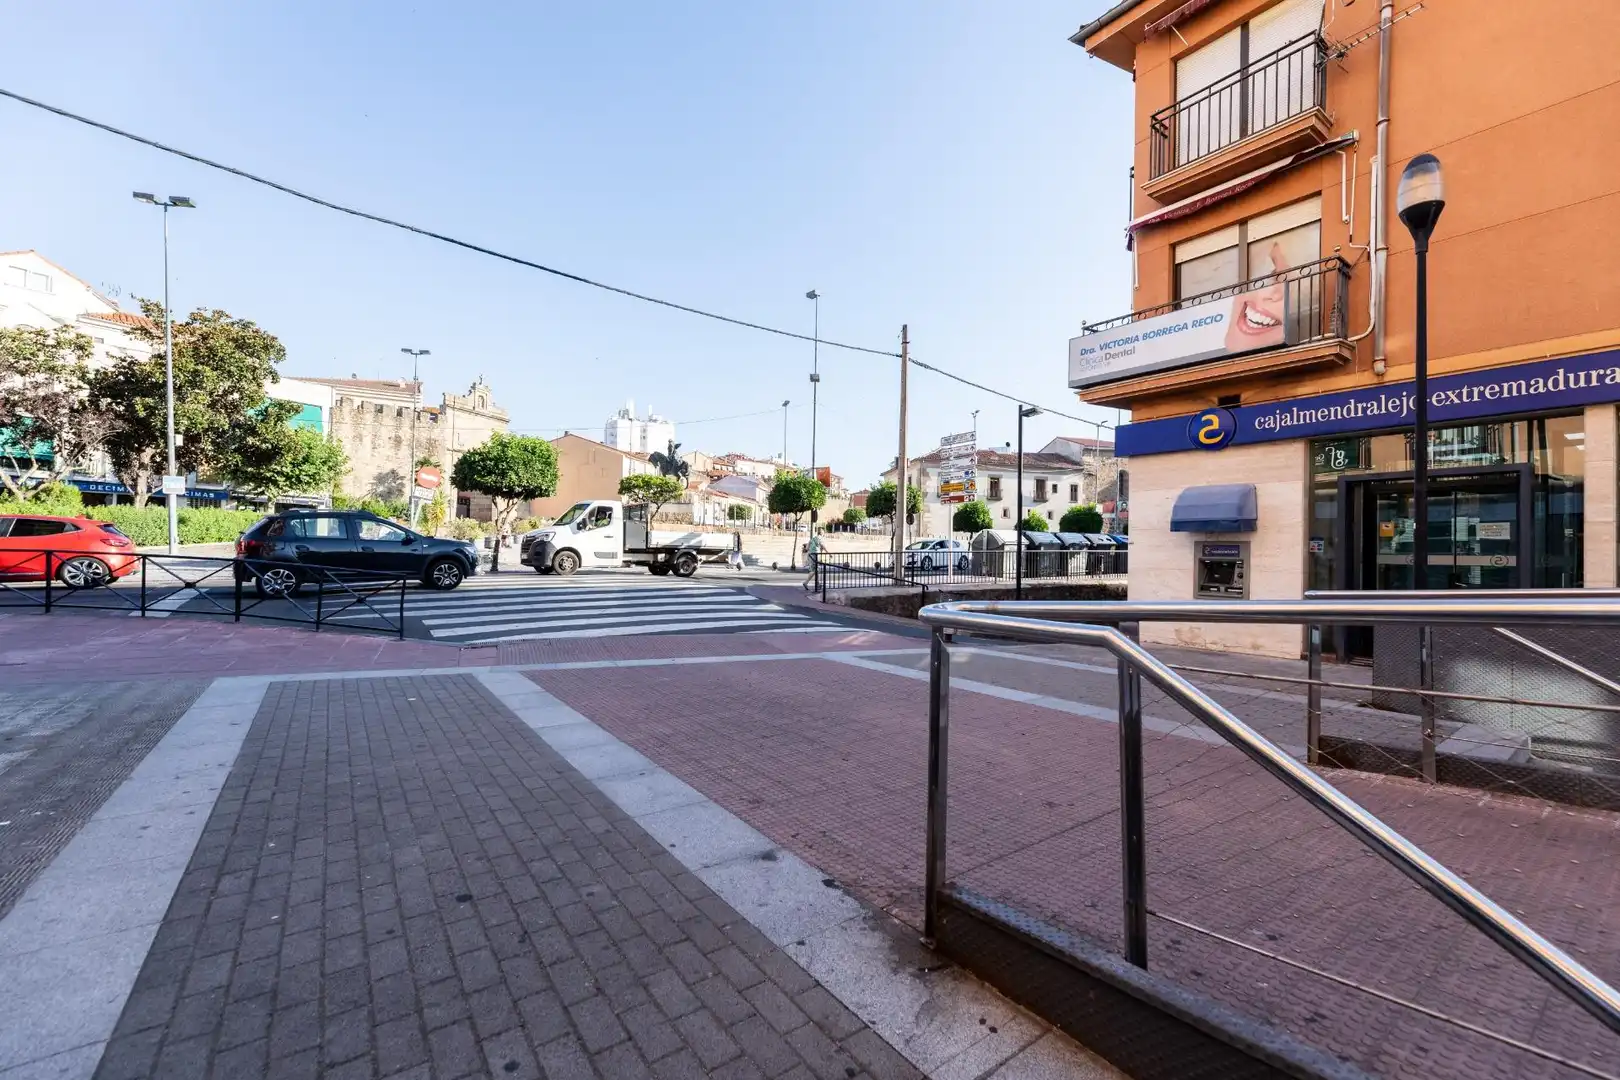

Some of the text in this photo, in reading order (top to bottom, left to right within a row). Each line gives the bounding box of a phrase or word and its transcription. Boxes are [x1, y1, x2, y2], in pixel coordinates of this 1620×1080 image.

[1080, 313, 1224, 356] Dra. VICTORIA BORREGA RECIO
[1104, 345, 1136, 361] Dental
[89, 484, 130, 493] DECIM
[184, 491, 215, 499] CIMAS
